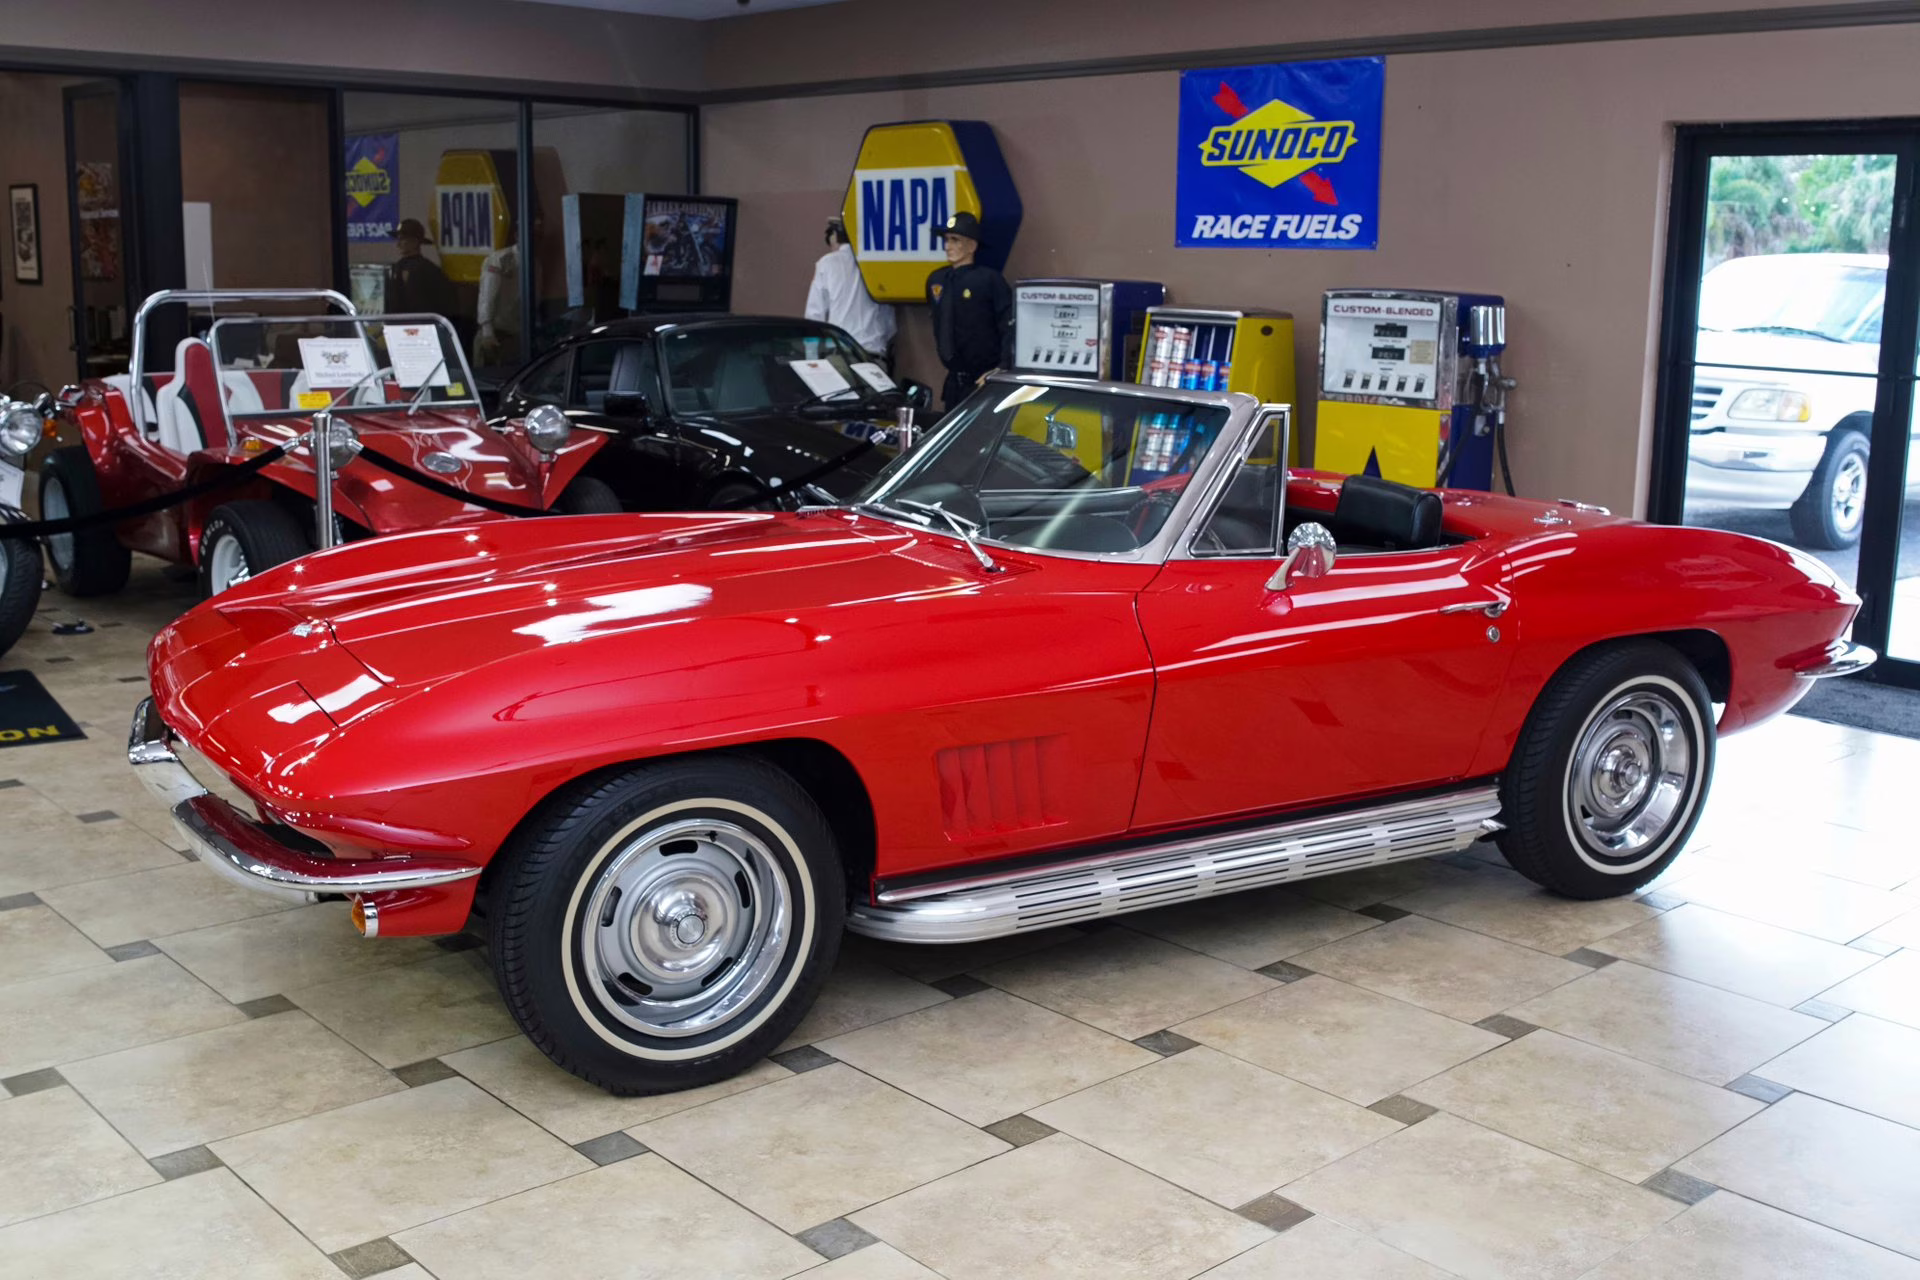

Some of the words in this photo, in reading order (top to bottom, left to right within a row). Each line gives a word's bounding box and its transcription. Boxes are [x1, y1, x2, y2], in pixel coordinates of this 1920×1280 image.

[1205, 125, 1350, 162] SUNOCO
[862, 177, 948, 251] NAPA
[1191, 214, 1270, 239] RACE
[1270, 213, 1363, 240] FUELS
[1020, 292, 1095, 301] CUSTOM-BLENDED
[1333, 304, 1434, 317] CUSTOM-BLENDED
